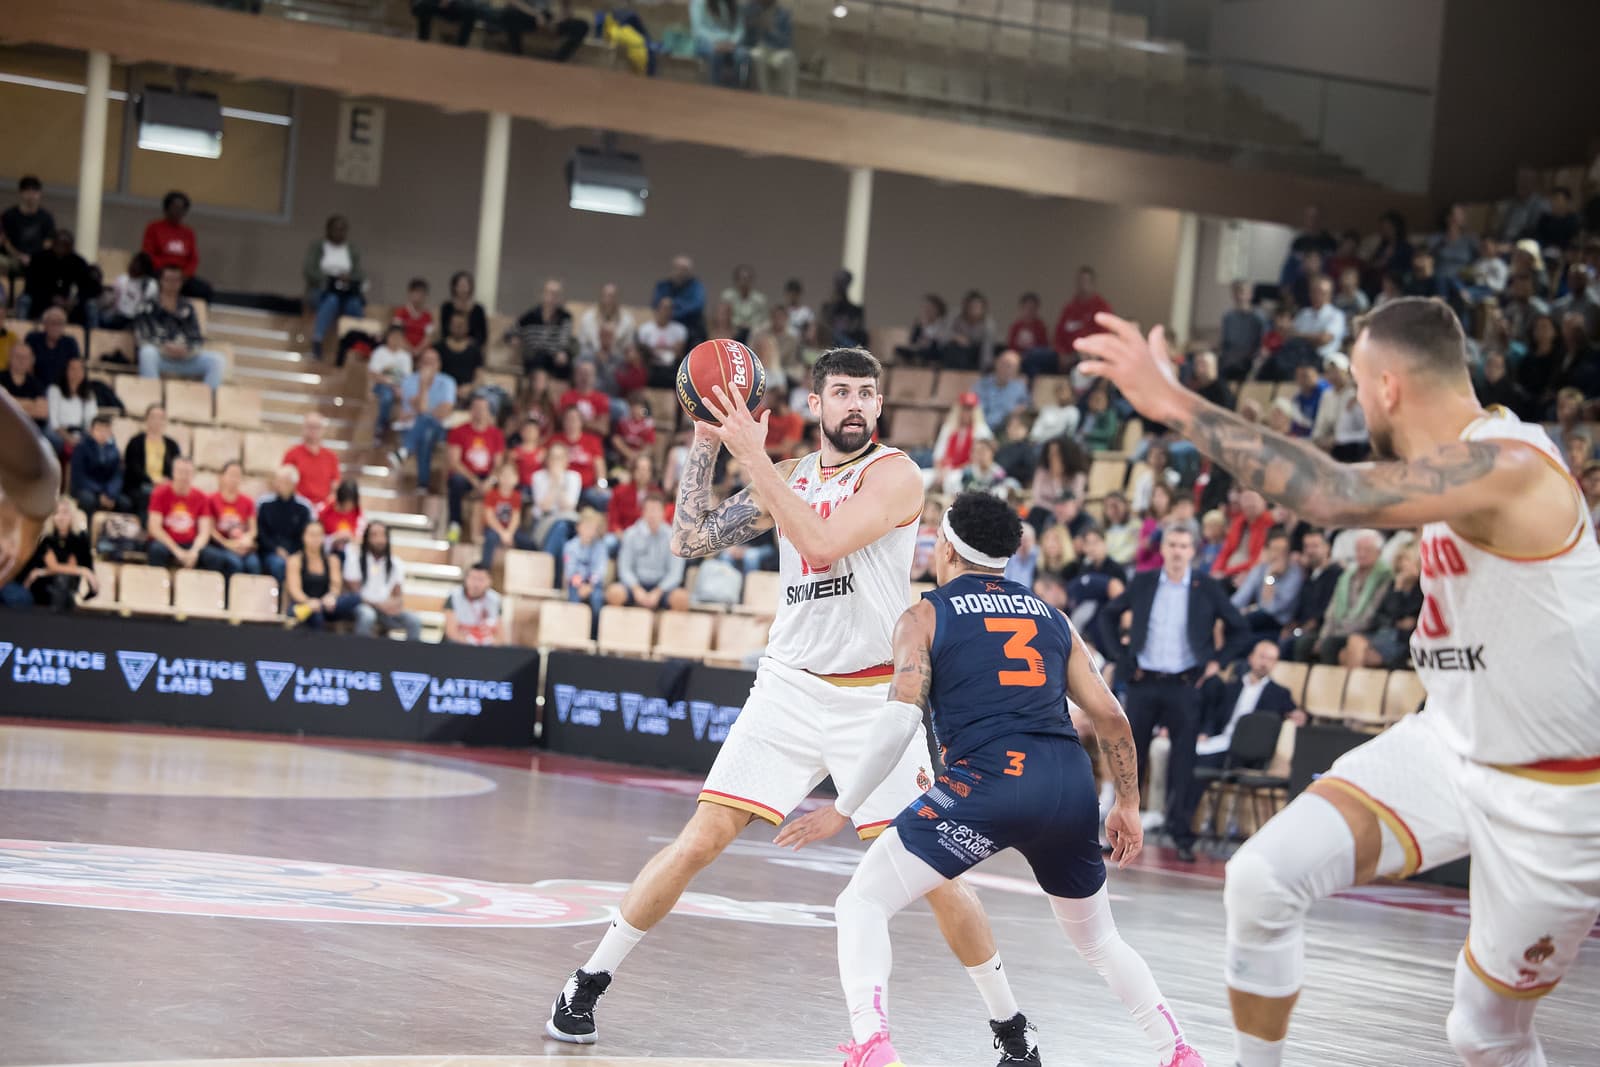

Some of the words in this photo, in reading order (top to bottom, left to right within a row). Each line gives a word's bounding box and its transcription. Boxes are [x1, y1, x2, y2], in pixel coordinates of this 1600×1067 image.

[351, 107, 372, 144] E
[786, 572, 855, 606] SKWEEK
[950, 593, 1052, 619] ROBINSON
[14, 648, 106, 670] LATTICE
[983, 618, 1047, 687] 3
[12, 665, 71, 685] LABS
[158, 657, 247, 681] LATTICE
[295, 667, 382, 691] LATTICE
[156, 676, 213, 696] LABS
[294, 686, 349, 706] LABS
[430, 677, 513, 701] LATTICE
[428, 696, 483, 716] LABS
[1003, 750, 1026, 777] 3
[957, 825, 994, 848] GROUPE
